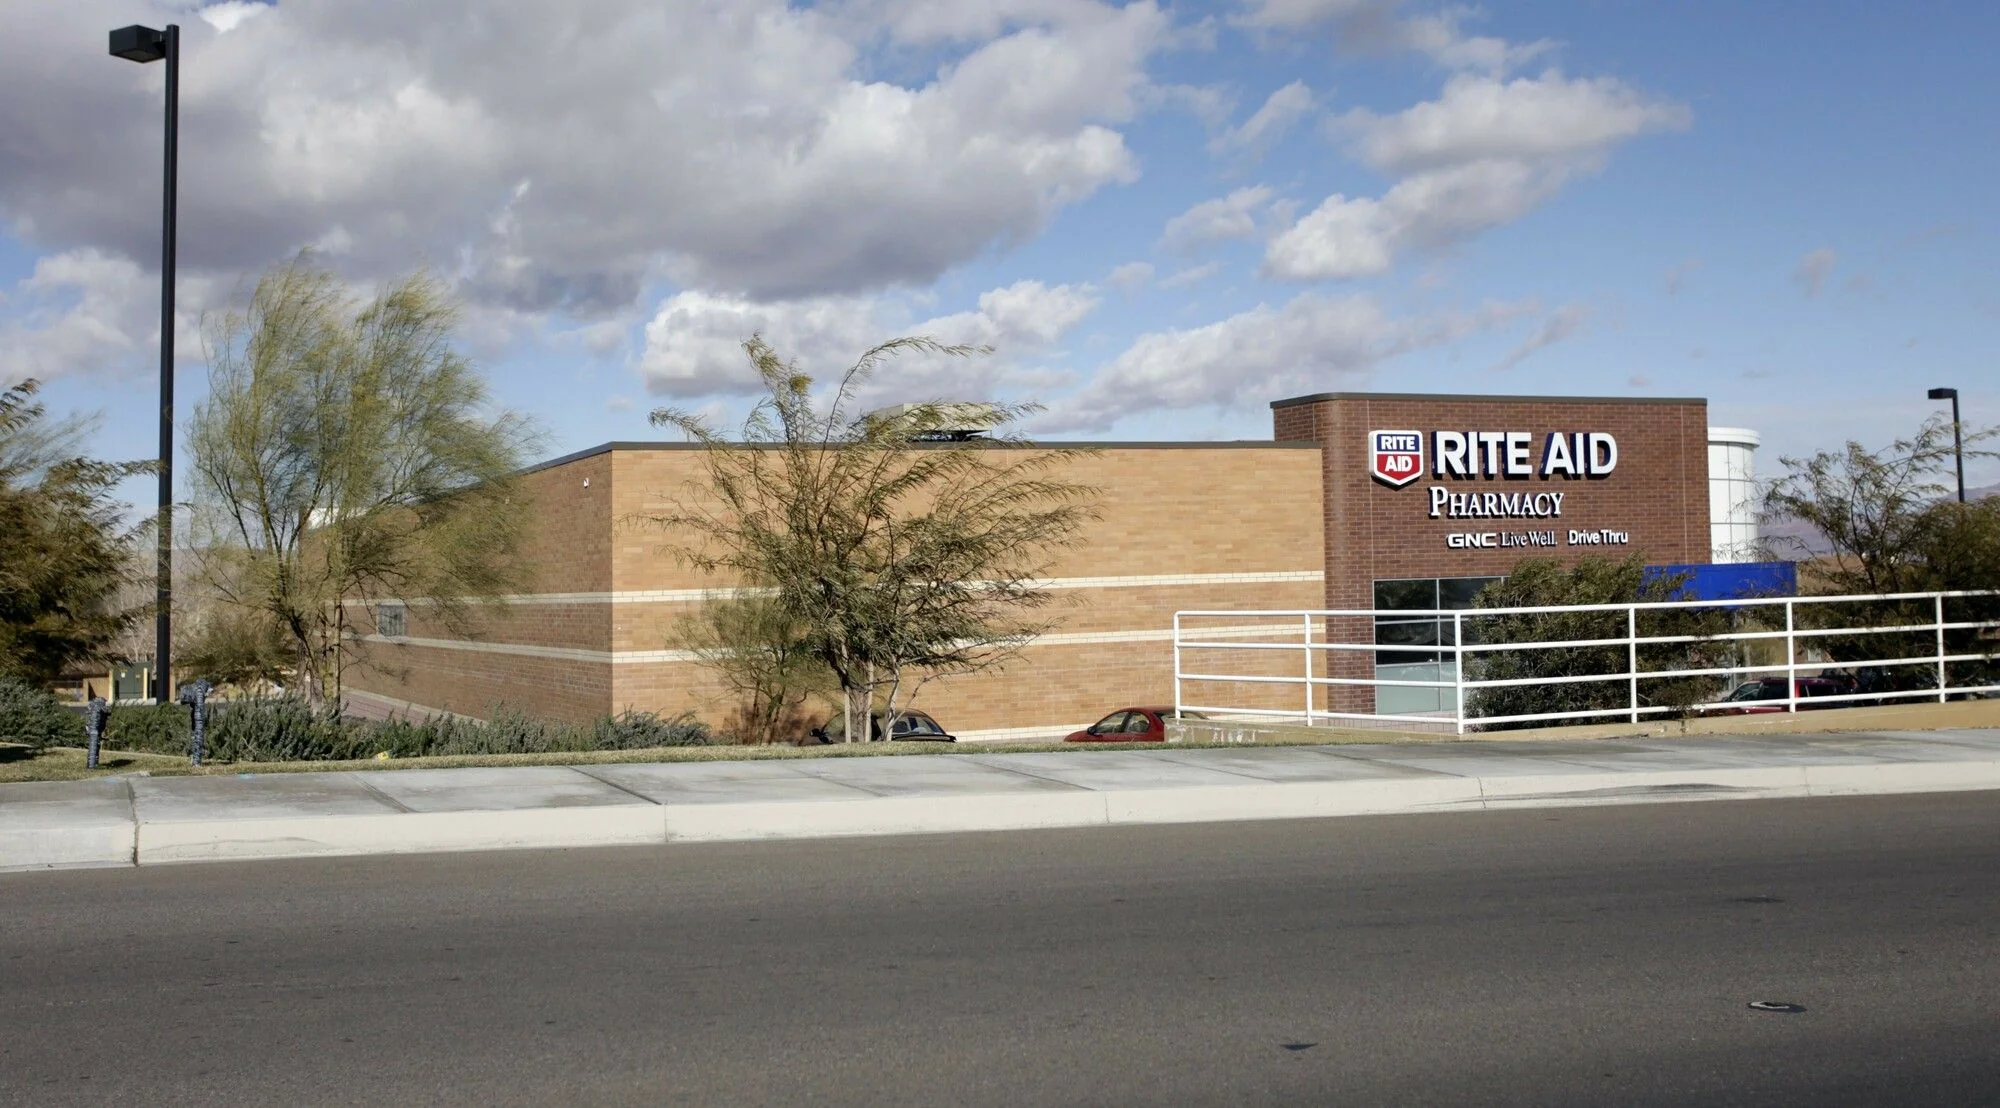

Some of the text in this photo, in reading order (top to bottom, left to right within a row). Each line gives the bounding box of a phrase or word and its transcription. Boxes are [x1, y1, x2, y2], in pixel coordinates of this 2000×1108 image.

[1380, 435, 1416, 450] RITE
[1435, 431, 1618, 476] RITE AID
[1385, 455, 1413, 472] AID
[1429, 486, 1564, 517] PHARMACY
[1448, 532, 1497, 547] GNC
[1501, 532, 1527, 546] Live
[1569, 529, 1628, 544] Drive Thru
